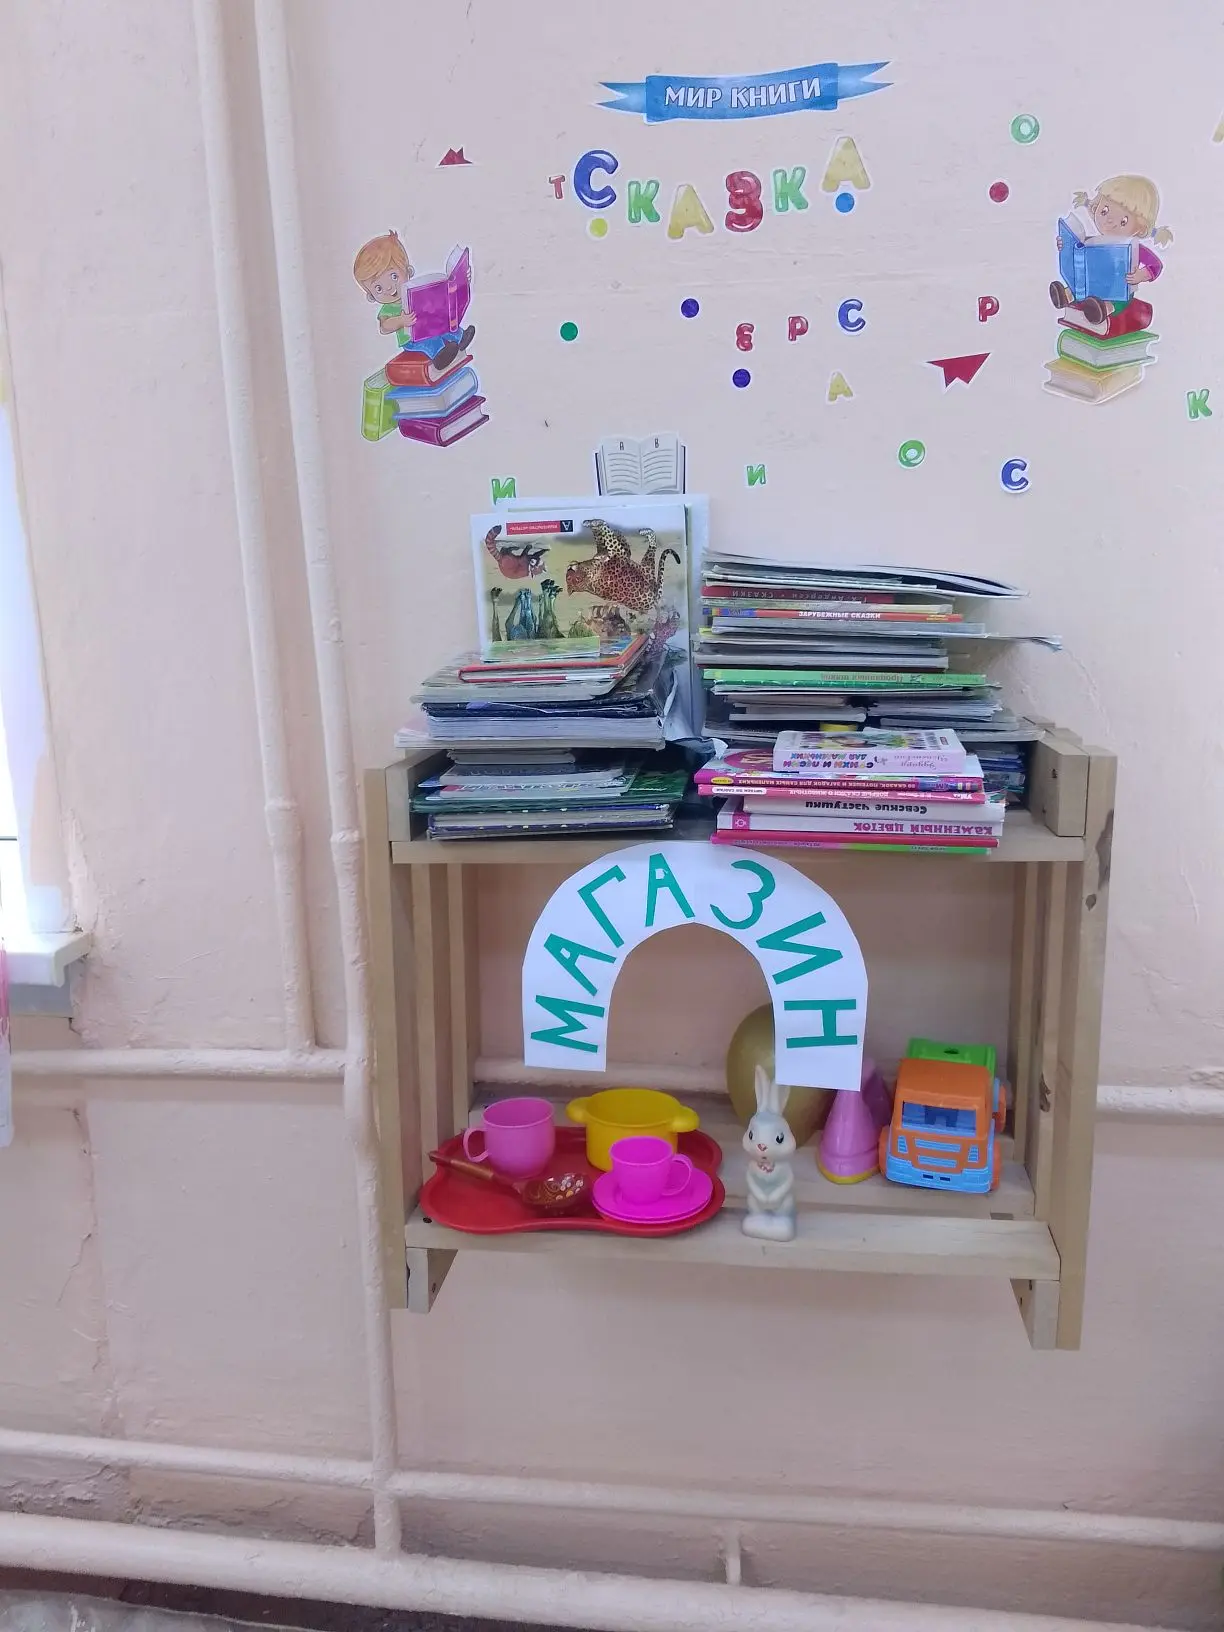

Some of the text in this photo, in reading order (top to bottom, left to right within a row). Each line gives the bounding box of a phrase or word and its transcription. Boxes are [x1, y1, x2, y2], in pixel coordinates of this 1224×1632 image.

[664, 77, 821, 109] МИР КНИГИ
[798, 610, 881, 620] ЗАРУБЕЖНЫЕ СКАЗКИ
[805, 800, 927, 815] Севские частушки
[854, 822, 904, 833] ЦВЕТОК
[530, 852, 858, 1053] МАГАЗИН
